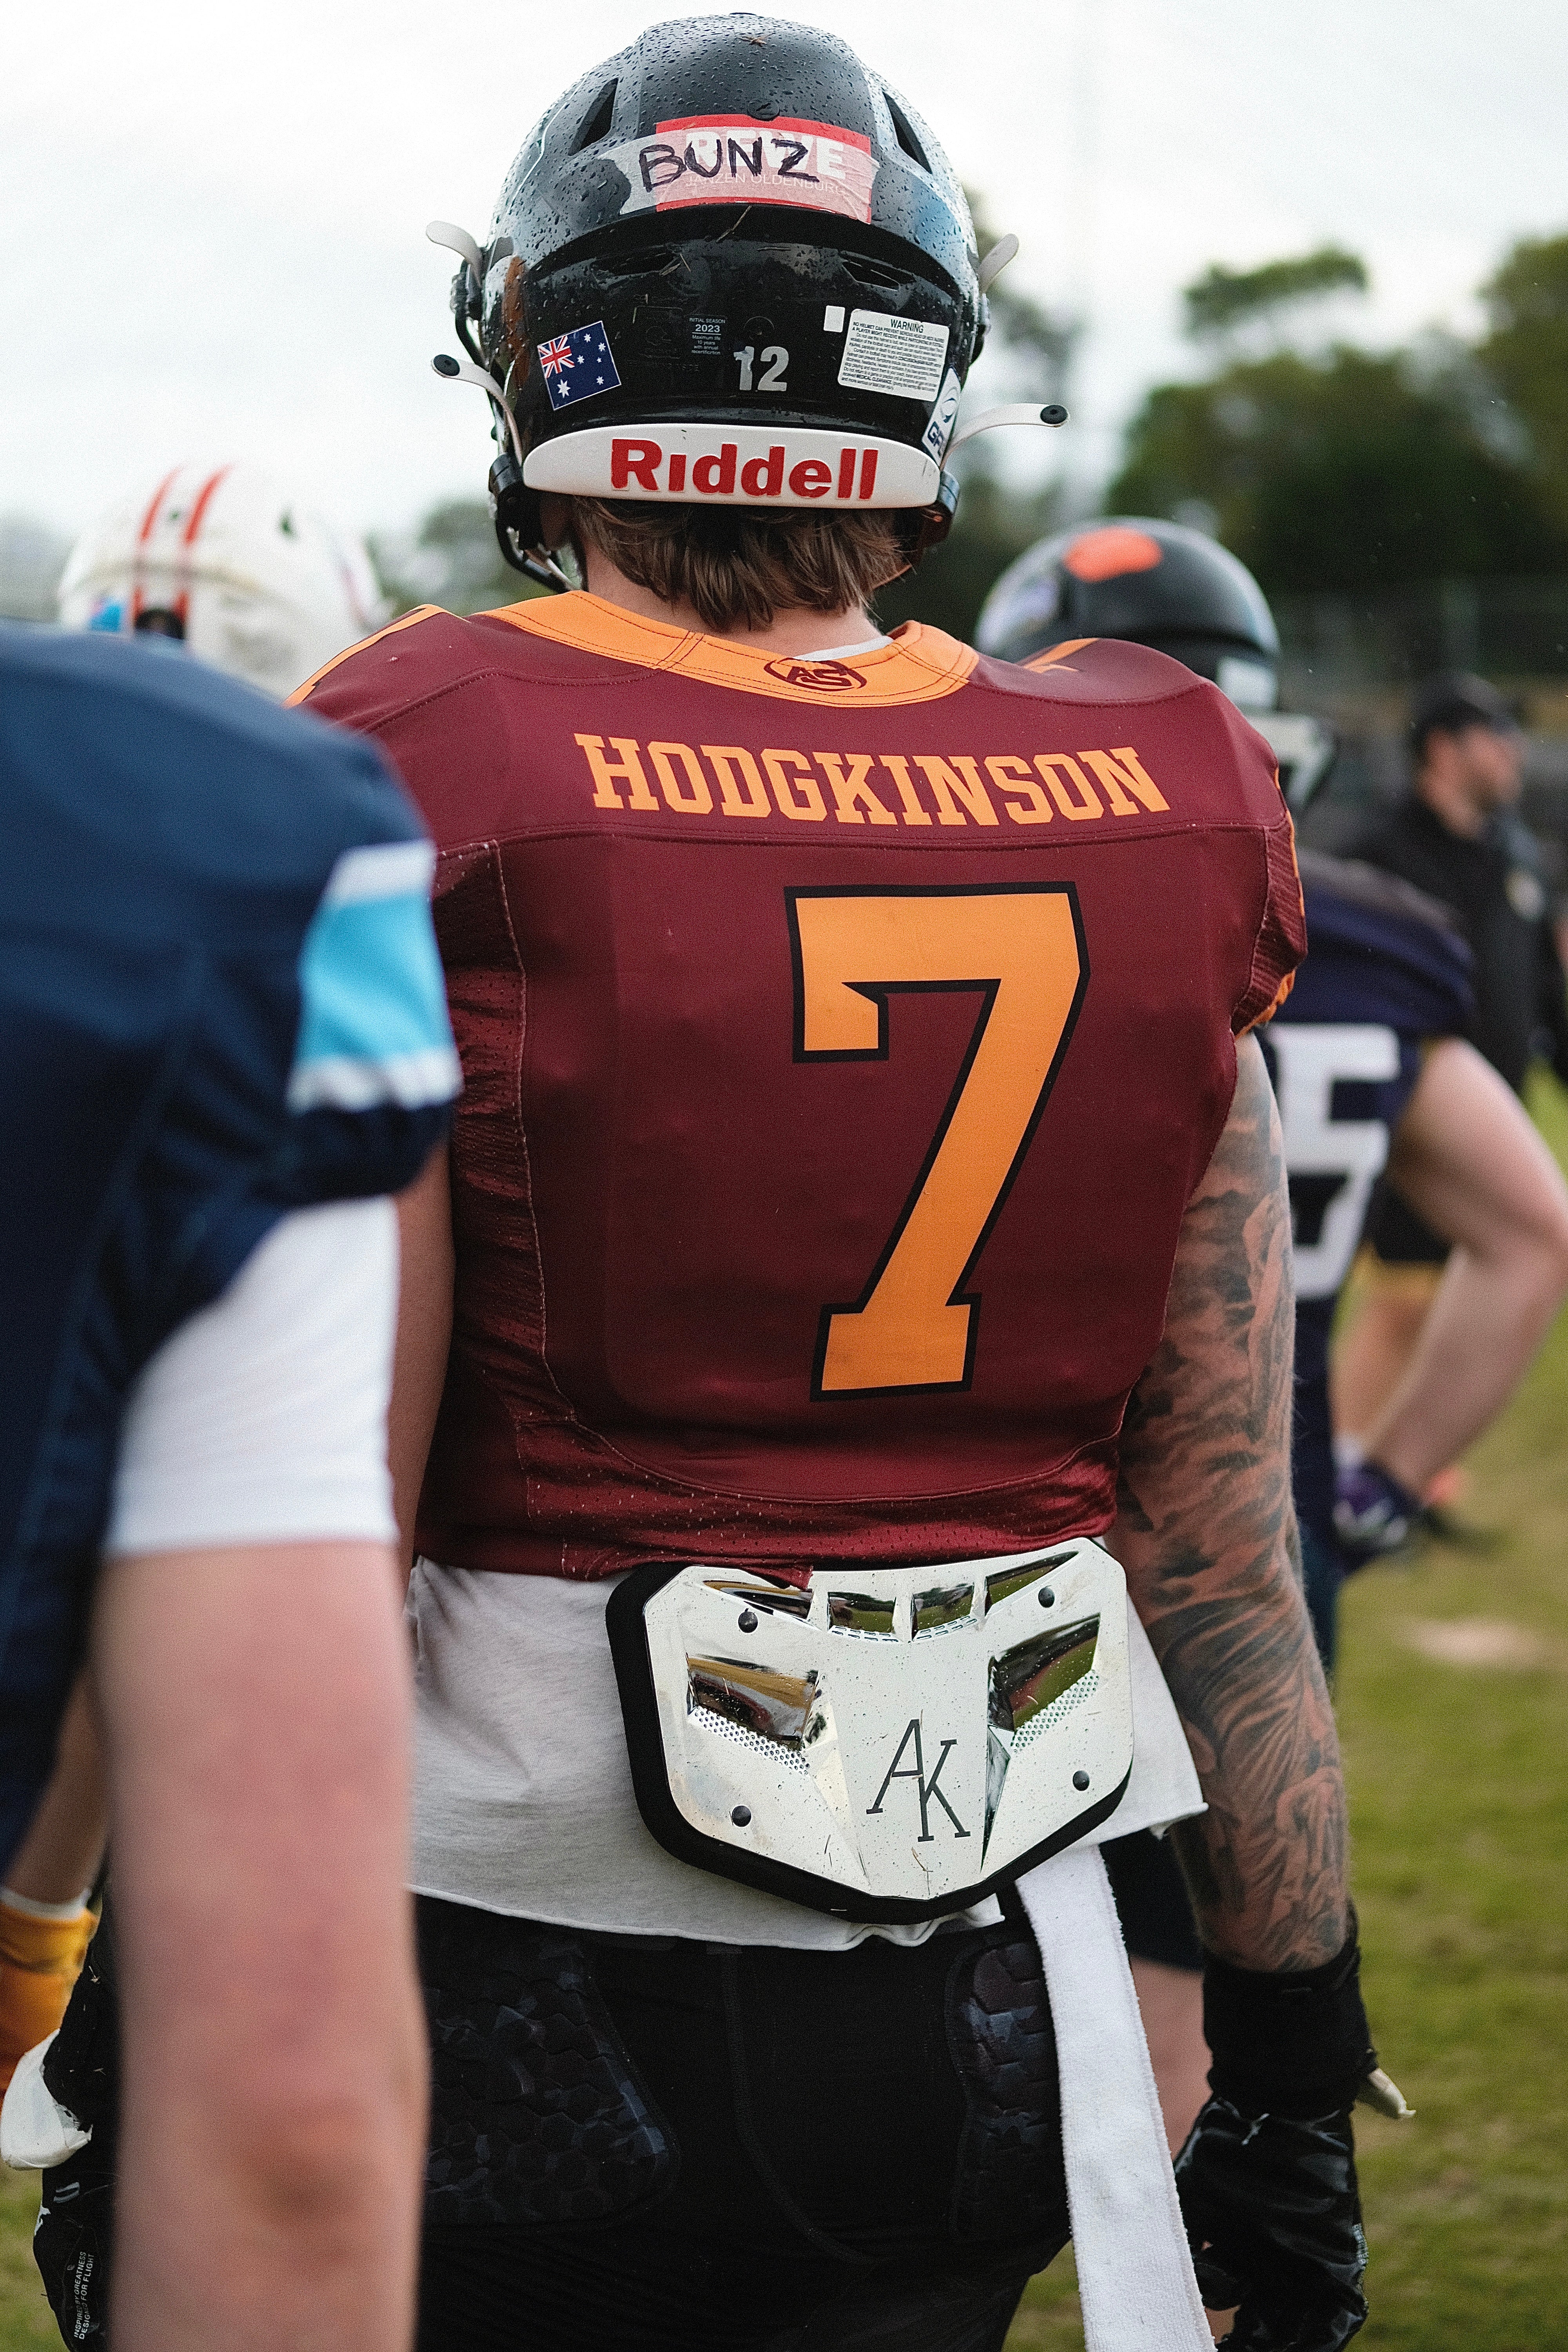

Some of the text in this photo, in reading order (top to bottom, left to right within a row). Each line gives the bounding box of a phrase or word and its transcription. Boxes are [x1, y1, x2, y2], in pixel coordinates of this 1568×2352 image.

[639, 136, 820, 192] BUNZ
[686, 130, 846, 180] REWE
[695, 324, 720, 332] 2023
[891, 319, 924, 333] WARNING
[733, 346, 789, 392] 12
[611, 438, 879, 500] Riddell
[573, 733, 1171, 826] HODGKINSON
[784, 881, 1091, 1402] 7
[866, 1719, 971, 1842] AK
[74, 2251, 87, 2295] GREATNESS
[83, 2254, 94, 2283] FLIGHT
[74, 2304, 83, 2338] INSPIRED
